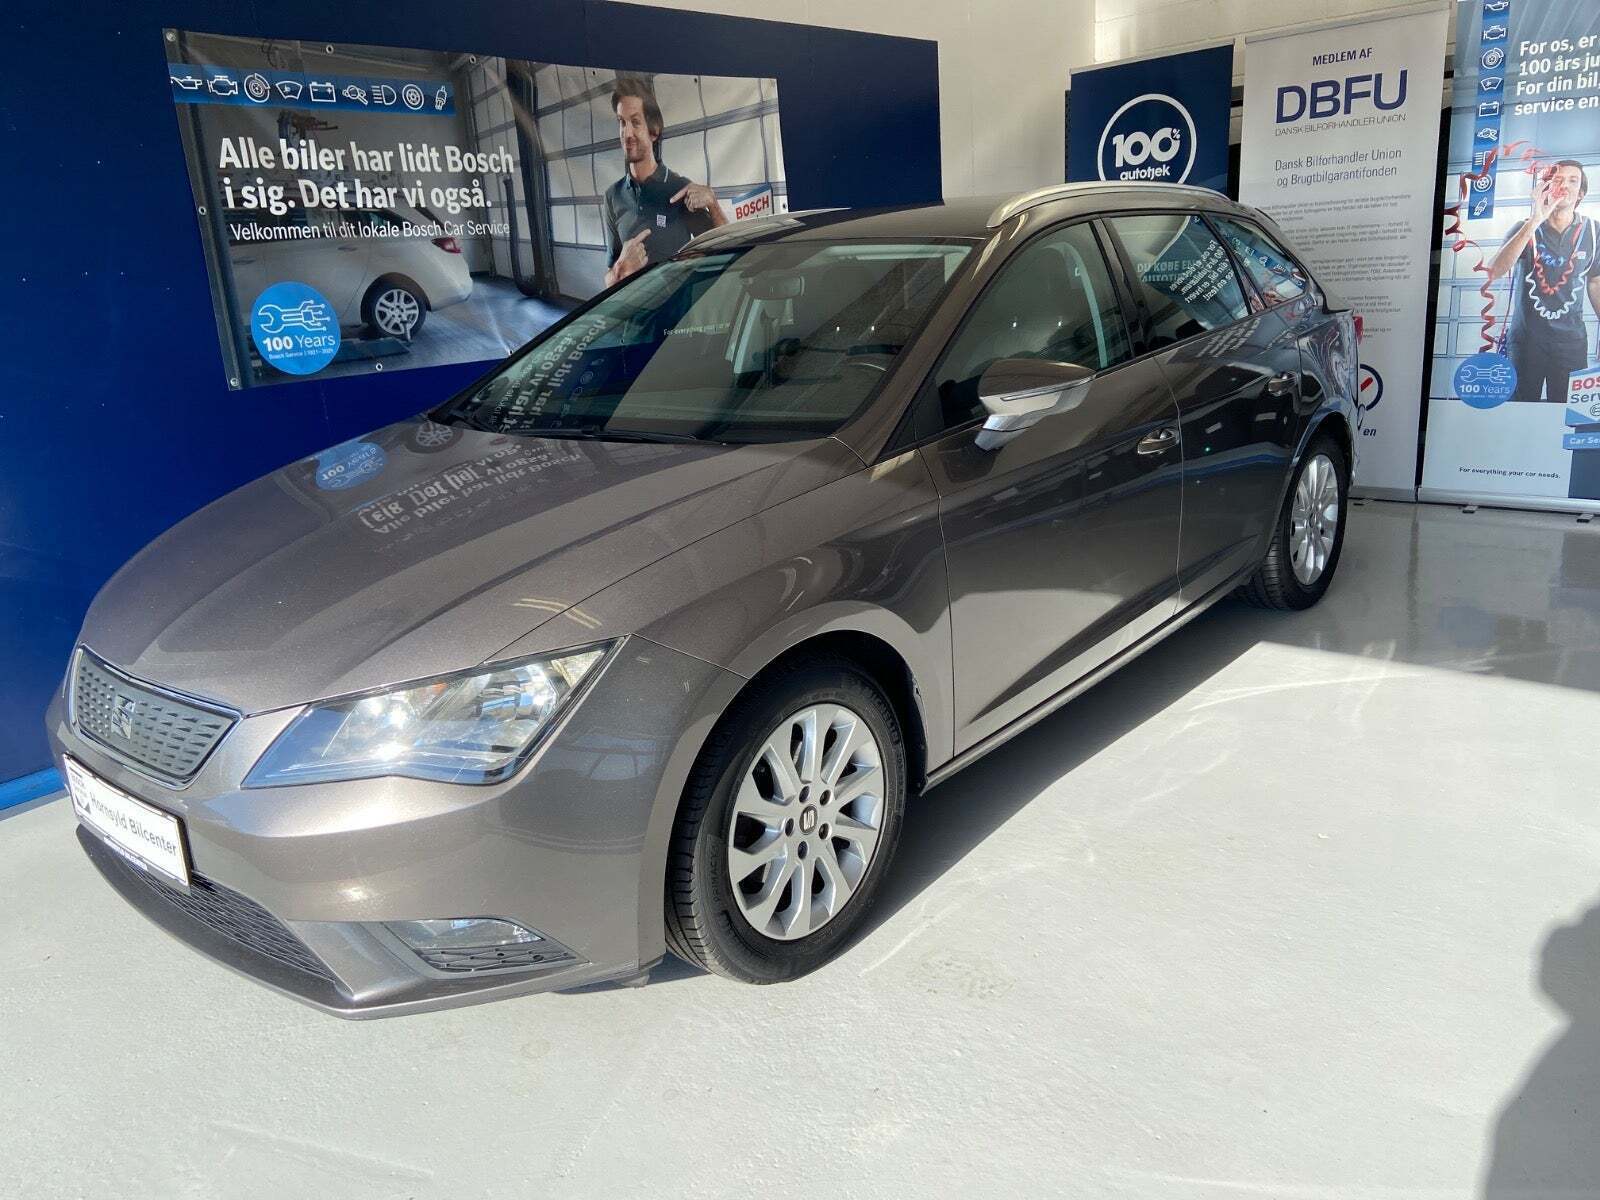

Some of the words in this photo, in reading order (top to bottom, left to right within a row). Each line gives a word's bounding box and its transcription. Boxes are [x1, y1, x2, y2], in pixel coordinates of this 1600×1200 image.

[1312, 49, 1356, 66] MEDLEM
[1359, 47, 1373, 59] AF
[1520, 41, 1547, 57] For
[1551, 39, 1574, 52] os,
[1579, 35, 1597, 48] er
[1519, 58, 1551, 76] 100
[1555, 55, 1580, 71] års
[1275, 69, 1408, 124] DBFU
[1516, 81, 1544, 96] For
[1547, 76, 1573, 93] din
[1514, 97, 1575, 116] service
[1578, 95, 1599, 109] en
[1275, 125, 1303, 137] DANSK
[1304, 116, 1376, 133] BILFORHANDLER
[1376, 113, 1407, 124] UNION
[219, 136, 276, 169] Alle
[279, 138, 346, 171] biler
[349, 141, 394, 172] har
[398, 142, 442, 173] lidt
[444, 145, 514, 174] Bosch
[1275, 159, 1304, 171] Dansk
[1306, 150, 1368, 168] Bilforhandler
[1371, 149, 1402, 160] Union
[1120, 164, 1171, 181] autotjek
[1276, 177, 1289, 188] og
[1291, 165, 1398, 186] Brugtbilgarantifonden
[223, 177, 235, 209] i
[241, 177, 297, 216] sig.
[297, 179, 351, 209] Det
[354, 178, 398, 209] har
[401, 180, 427, 208] vi
[430, 179, 493, 215] også.
[735, 194, 770, 220] BOSCH
[230, 222, 321, 240] Velkommen
[323, 221, 337, 238] til
[338, 221, 357, 238] dit
[358, 221, 401, 238] lokale
[402, 221, 442, 238] Bosch
[443, 220, 465, 236] Car
[467, 219, 511, 236] Service
[262, 335, 293, 352] 100
[294, 334, 336, 349] Years
[1460, 384, 1480, 393] 100
[1482, 384, 1511, 394] Years
[1570, 437, 1585, 445] Car
[1471, 468, 1507, 477] everything
[89, 791, 128, 830] Hornsyld
[128, 818, 177, 856] Bilcenter
